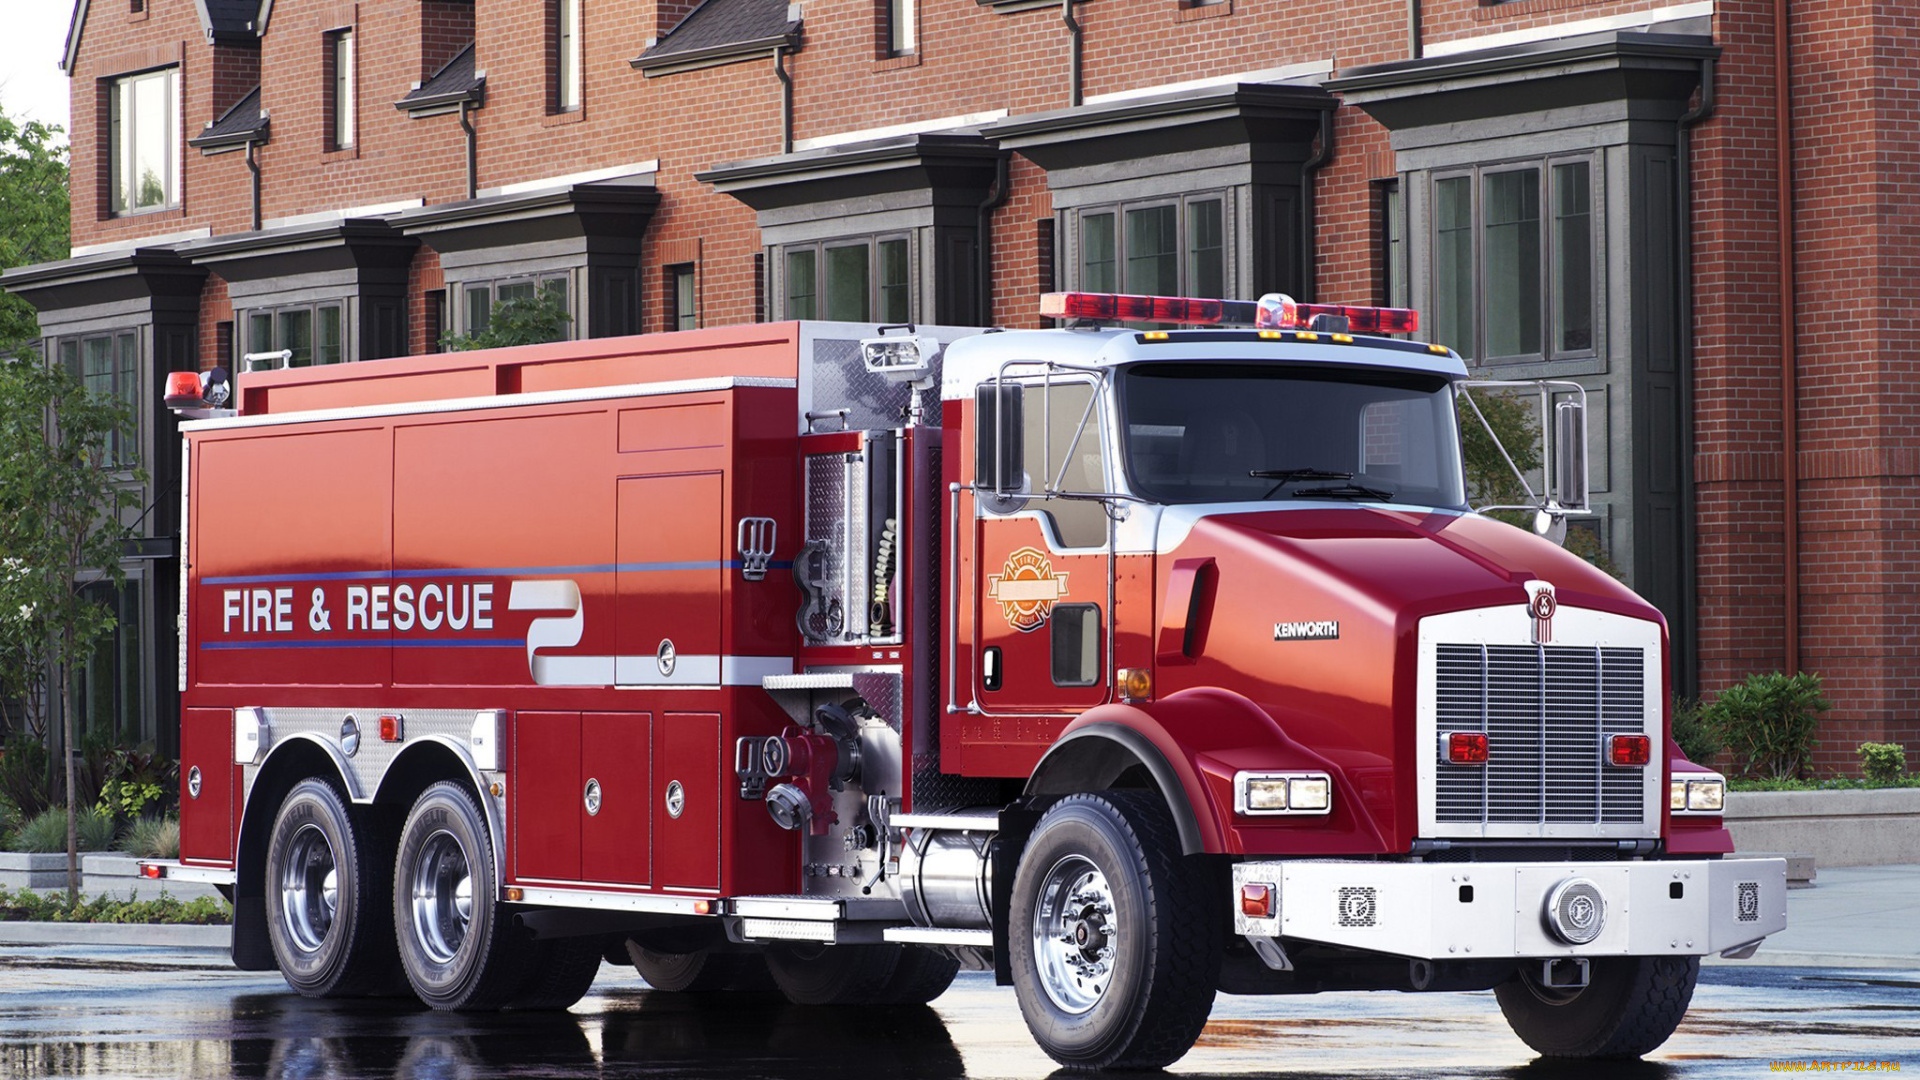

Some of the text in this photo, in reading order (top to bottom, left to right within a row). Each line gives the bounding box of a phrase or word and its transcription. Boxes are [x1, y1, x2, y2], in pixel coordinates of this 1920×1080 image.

[223, 583, 494, 633] FIRE & RESCUE
[1274, 621, 1338, 639] KENWORTH
